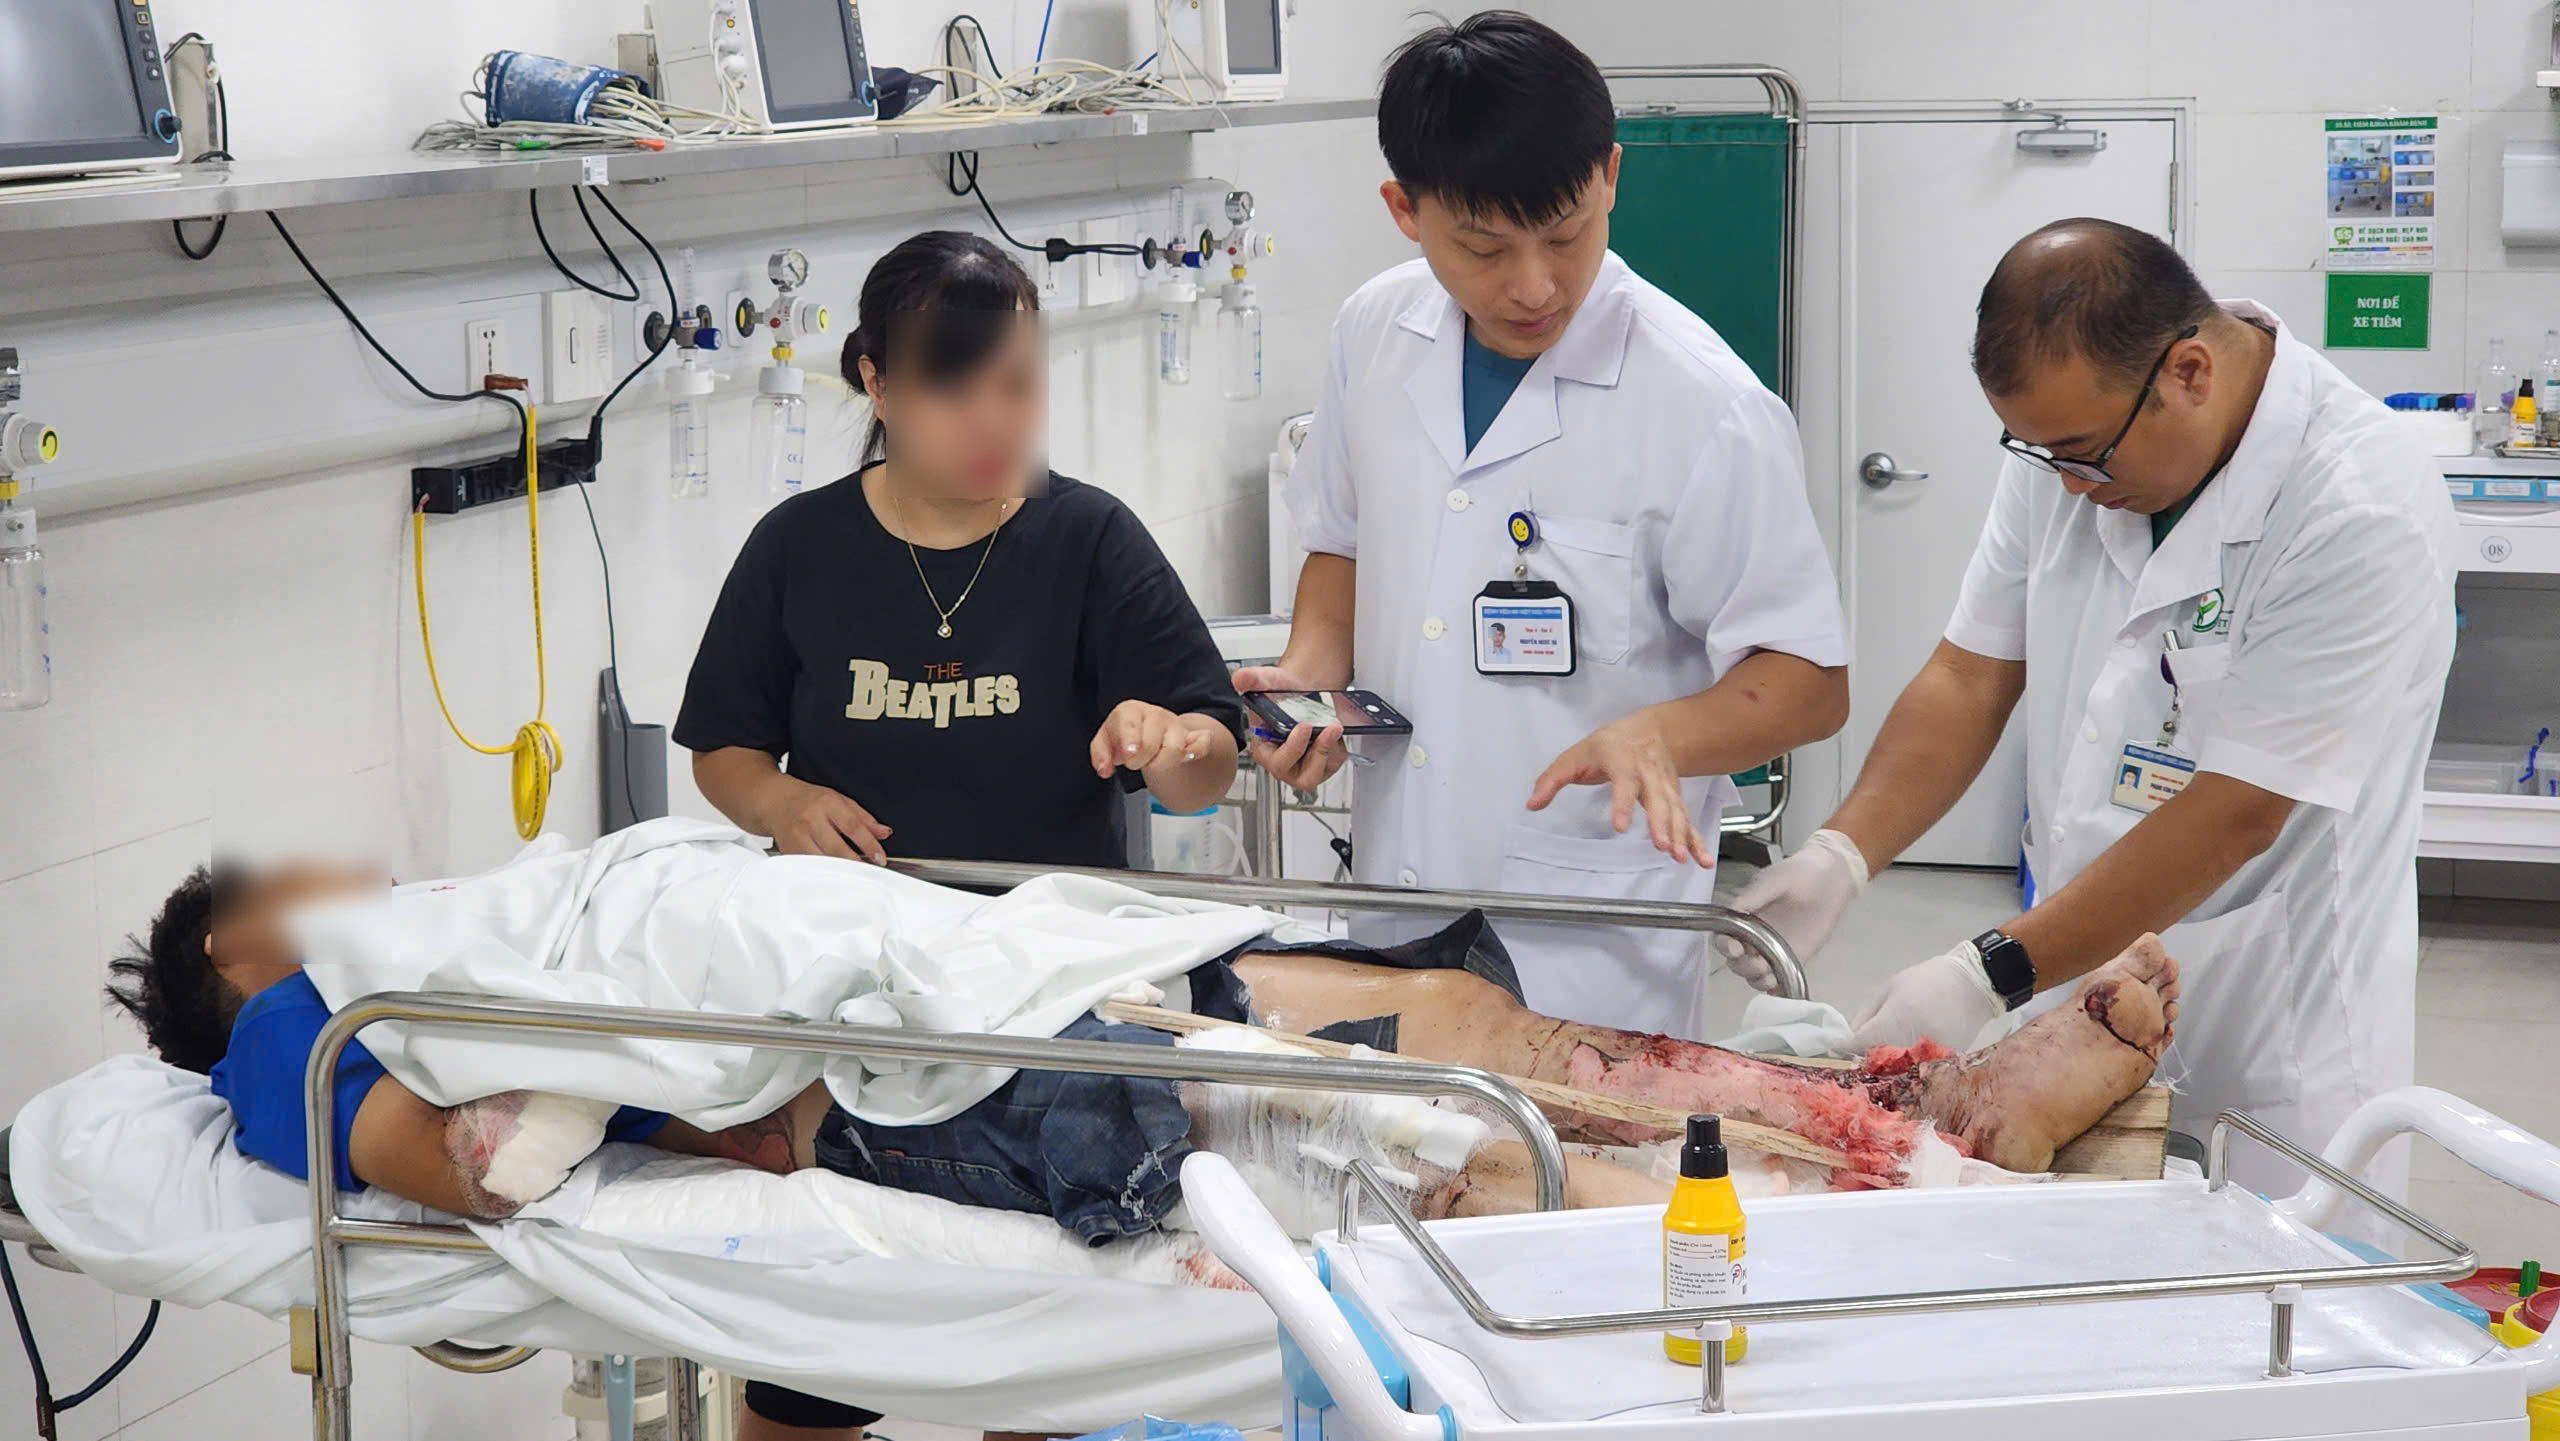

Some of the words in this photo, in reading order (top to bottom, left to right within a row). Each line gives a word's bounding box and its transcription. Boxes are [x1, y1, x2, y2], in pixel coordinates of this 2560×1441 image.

[2353, 316, 2370, 328] XE
[2371, 314, 2402, 329] TIÊM
[2488, 544, 2504, 556] 08
[923, 661, 964, 680] THE
[845, 659, 1021, 729] BEATLES
